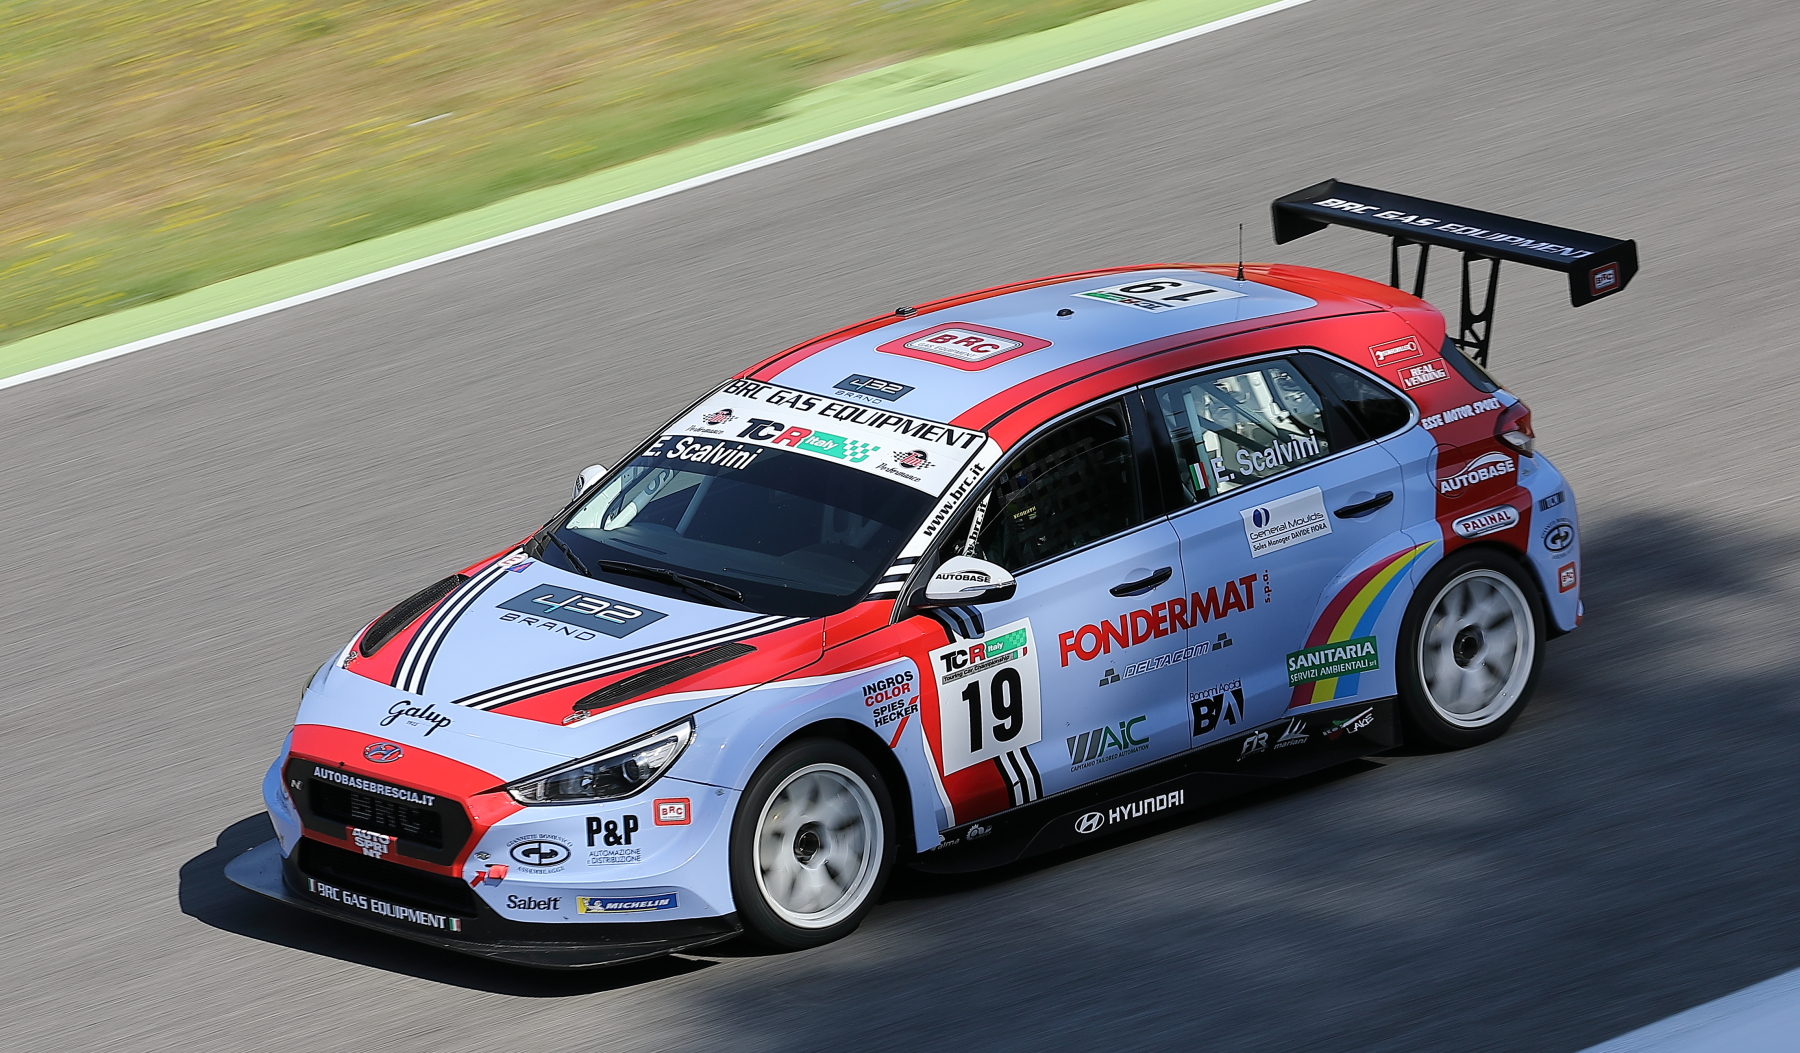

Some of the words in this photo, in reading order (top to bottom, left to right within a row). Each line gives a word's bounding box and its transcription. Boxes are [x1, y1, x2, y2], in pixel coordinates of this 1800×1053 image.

[1313, 198, 1378, 214] BRC
[1375, 210, 1440, 228] GAS
[1433, 222, 1595, 259] EQUIPMENT
[1119, 281, 1219, 301] 19
[1596, 273, 1614, 285] BRC
[928, 334, 1000, 353] BRC
[1404, 369, 1447, 387] VENDING
[1410, 364, 1436, 377] REAL
[835, 390, 882, 405] BRAND
[848, 377, 905, 395] 432
[722, 379, 767, 400] BRC
[765, 390, 814, 412] GAS
[817, 402, 986, 450] EQUIPMENT
[1421, 415, 1443, 431] ESSE
[1442, 407, 1474, 425] MOTOR
[1473, 398, 1502, 414] SPORT
[736, 417, 812, 449] TCR
[805, 434, 840, 451] Italy
[642, 435, 663, 458] E.
[667, 436, 763, 471] Scalvini
[1210, 456, 1236, 484] E.
[1237, 429, 1321, 477] Scalvini
[875, 462, 922, 482] Performance
[1440, 459, 1516, 494] AUTOBASE
[923, 462, 986, 537] www.brc.it
[965, 500, 988, 557] w.brc.it
[1249, 523, 1287, 540] General
[1287, 512, 1324, 529] Moulds
[1462, 510, 1511, 533] PALINAL
[1253, 543, 1267, 552] Sales
[1268, 536, 1290, 547] Manager
[1291, 528, 1311, 540] DAVIDE
[1311, 523, 1328, 533] FIORA
[935, 573, 991, 583] AUTOBASE
[531, 593, 644, 625] 432
[1058, 573, 1258, 668] FONDERMAT
[498, 612, 597, 642] BRAND
[940, 643, 986, 673] TCR
[987, 642, 1004, 653] Italy
[943, 671, 963, 682] Touring
[963, 667, 974, 676] Car
[975, 654, 1010, 671] Championship
[1123, 641, 1211, 679] DELTACOM
[1288, 641, 1375, 672] SANITARIA
[862, 670, 914, 697] INGROS
[1290, 669, 1318, 683] SERVIZI
[1320, 659, 1368, 676] AMBIENTALI
[1369, 659, 1377, 667] srl
[865, 682, 911, 708] COLOR
[1189, 686, 1219, 702] Bonomi
[1218, 677, 1242, 693] Acciai
[379, 700, 452, 738] Galup
[872, 699, 906, 718] SPIES
[874, 703, 919, 728] HECKER
[961, 667, 1023, 754] 19
[1346, 713, 1375, 734] LAKE
[1273, 737, 1309, 750] mariani
[1070, 761, 1095, 773] CAPITANIO
[1096, 753, 1118, 765] TAILORED
[1118, 744, 1149, 758] AUTOMATION
[313, 766, 436, 807] AUTOBASEBRESCIA.IT
[661, 806, 683, 816] BRC
[1108, 789, 1185, 825] HYUNDAI
[351, 827, 390, 845] AUTO
[586, 814, 639, 847] P&P
[354, 836, 388, 854] SPRI
[362, 847, 383, 859] NT
[588, 848, 641, 858] AUTOMAZIONE
[592, 855, 641, 864] DISTRIBUZIONE
[317, 881, 341, 903] BRC
[342, 890, 368, 910] GAS
[370, 899, 446, 930] EQUIPMENT
[506, 894, 560, 911] Sabelt
[606, 897, 670, 910] MICHELIN
